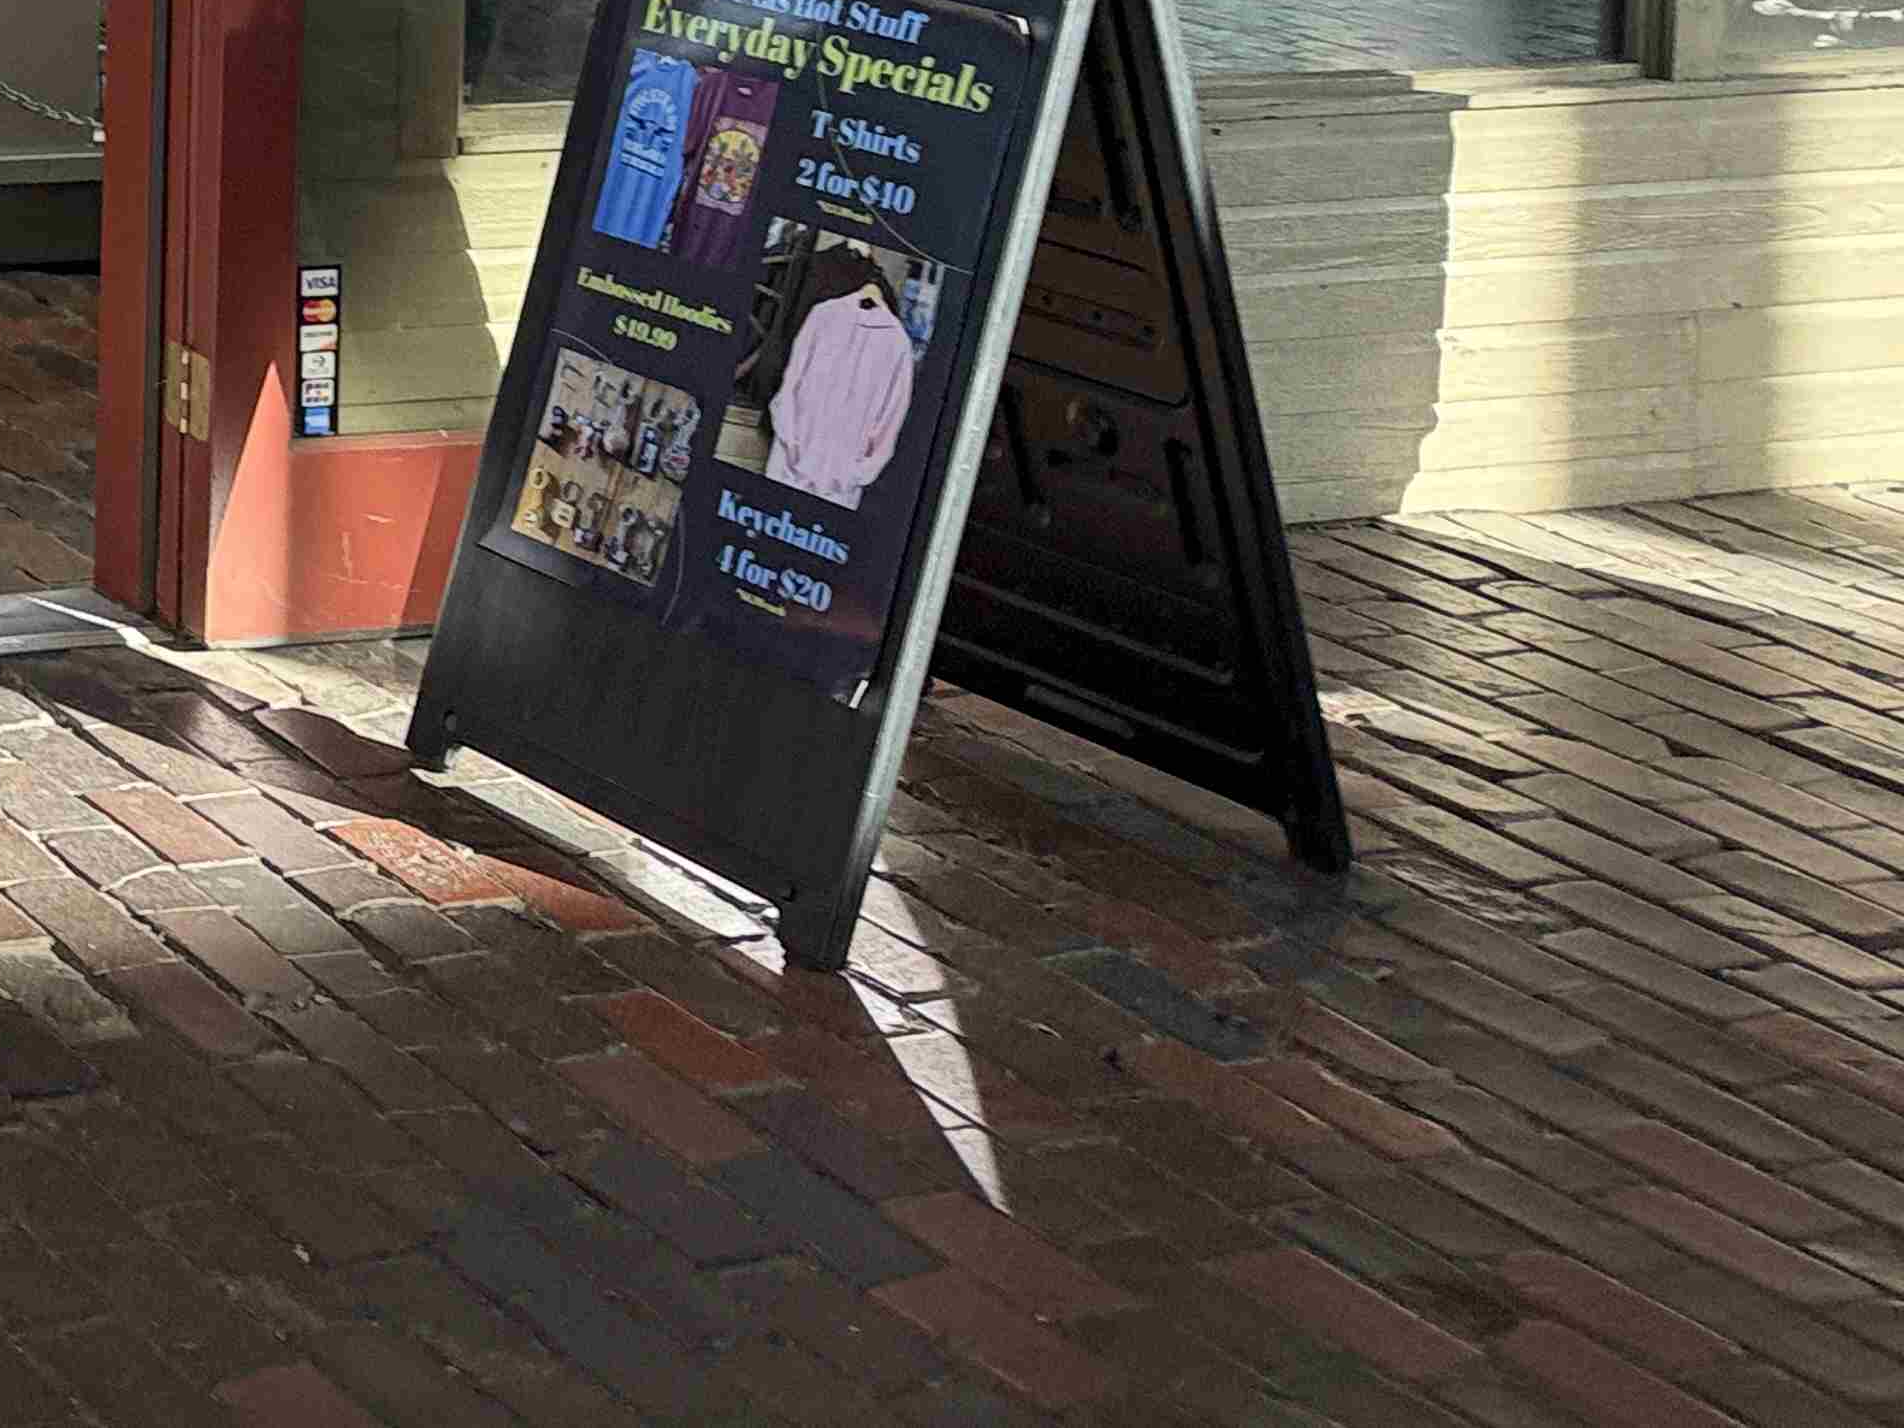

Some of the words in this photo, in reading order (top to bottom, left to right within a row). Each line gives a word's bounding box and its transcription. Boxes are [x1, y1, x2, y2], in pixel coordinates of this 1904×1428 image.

[845, 0, 930, 45] Stuff
[817, 34, 994, 114] Specials
[811, 109, 923, 164] T-Shirts
[795, 158, 817, 188] 2
[816, 161, 859, 199] for
[718, 489, 850, 565] Keychains
[735, 549, 778, 590] for
[778, 569, 833, 612] $20
